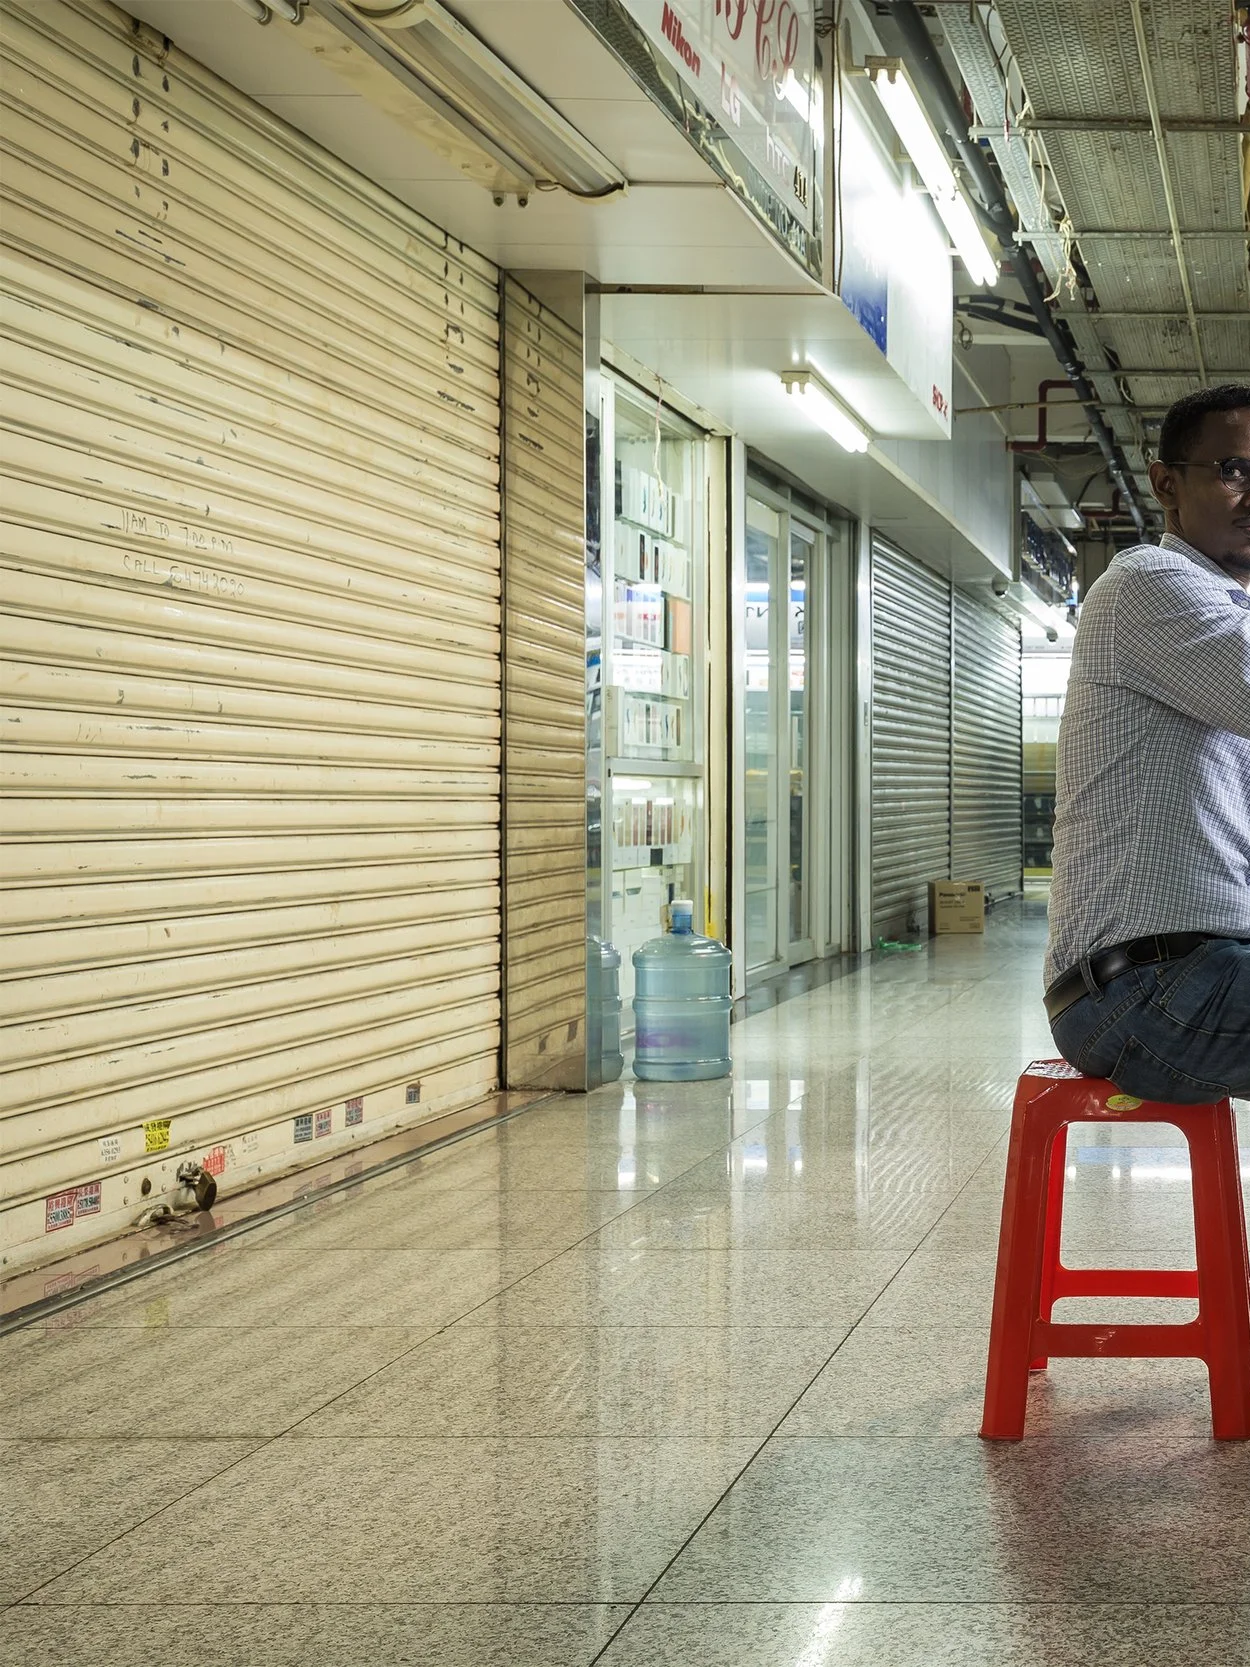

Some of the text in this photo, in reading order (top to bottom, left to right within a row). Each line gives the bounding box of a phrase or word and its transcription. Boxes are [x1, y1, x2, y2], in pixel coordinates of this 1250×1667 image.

[661, 1, 701, 78] Nikon
[721, 61, 741, 128] LG
[123, 554, 160, 575] CALL
